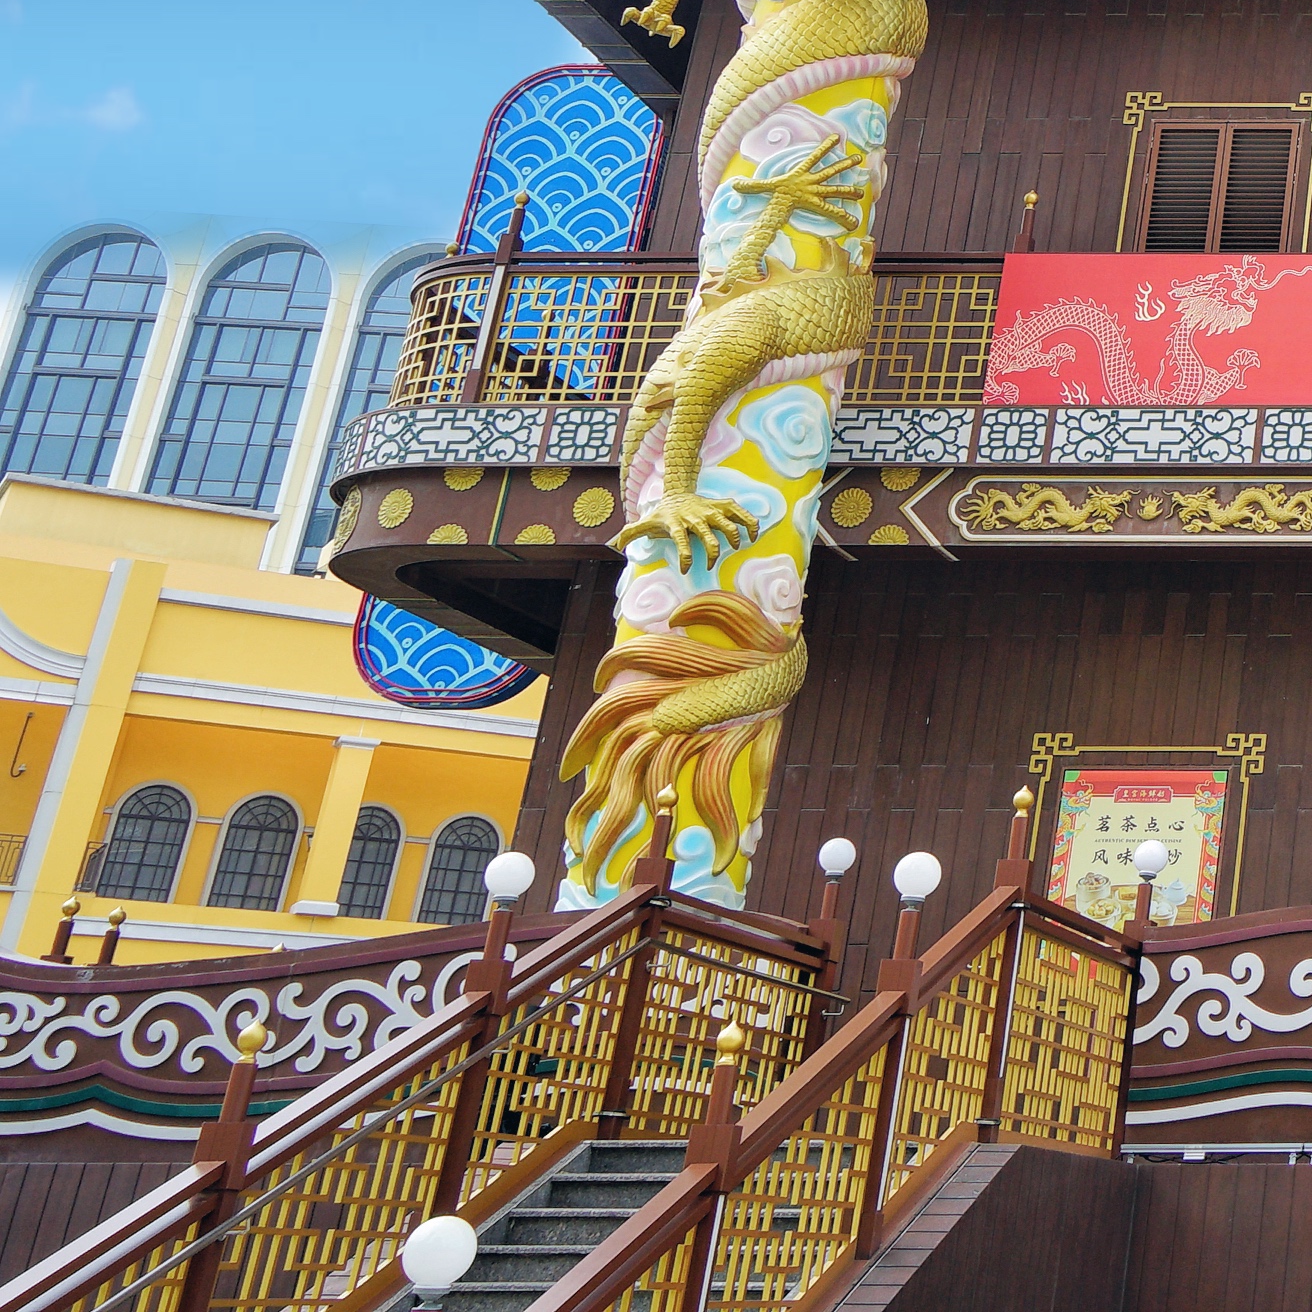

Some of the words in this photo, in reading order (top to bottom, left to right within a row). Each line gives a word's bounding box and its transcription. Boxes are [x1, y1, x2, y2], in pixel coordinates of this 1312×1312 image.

[1095, 815, 1186, 833] 茗茶点心
[1091, 848, 1183, 866] 风味炒
